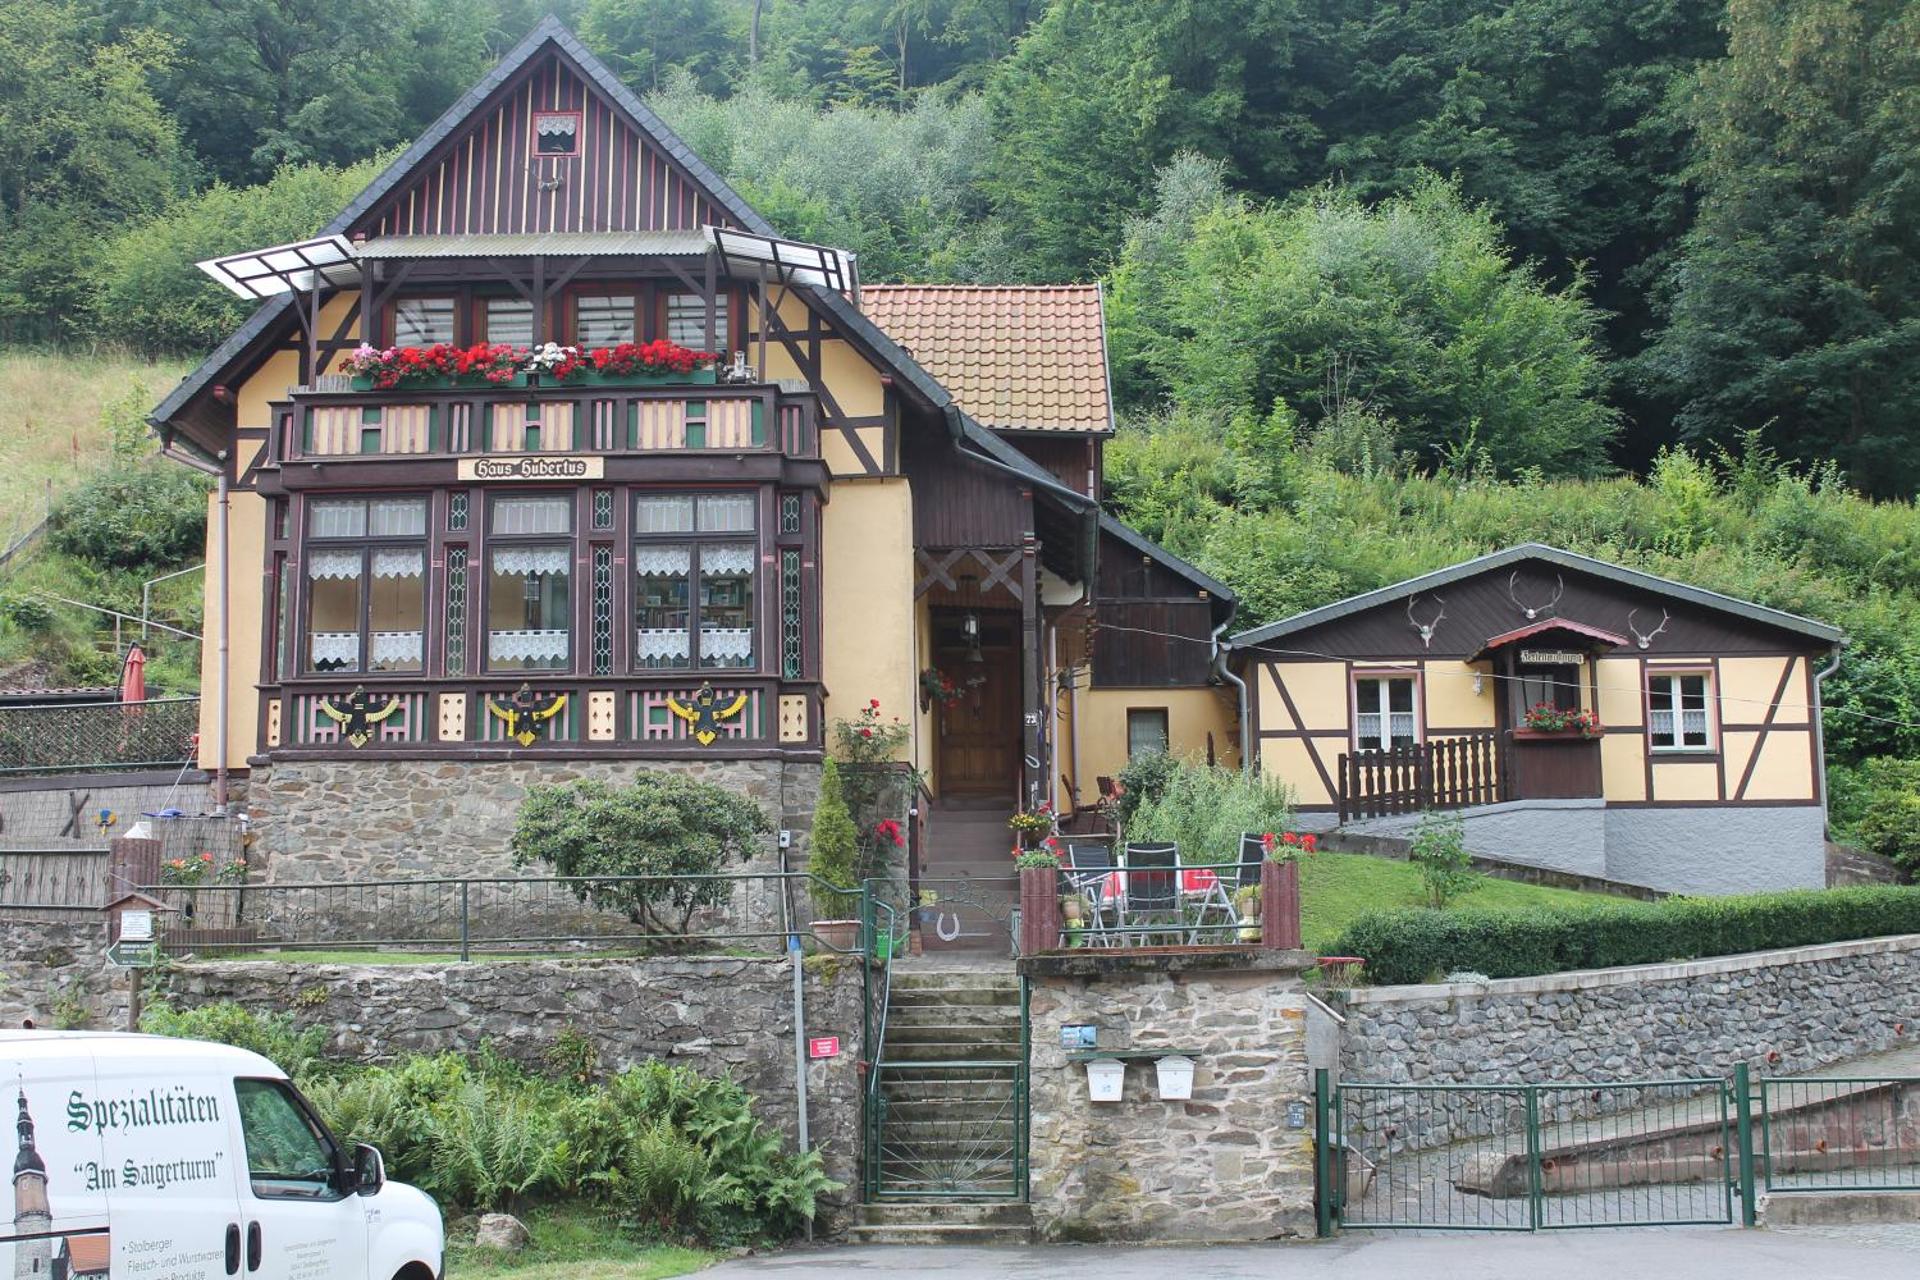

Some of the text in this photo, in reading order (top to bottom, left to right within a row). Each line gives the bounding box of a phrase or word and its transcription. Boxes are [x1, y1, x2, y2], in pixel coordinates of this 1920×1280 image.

[477, 458, 585, 478] Haus Hubertus
[67, 1086, 220, 1137] Spezialitäten
[128, 1239, 173, 1254] Stolberger
[160, 1256, 177, 1269] und
